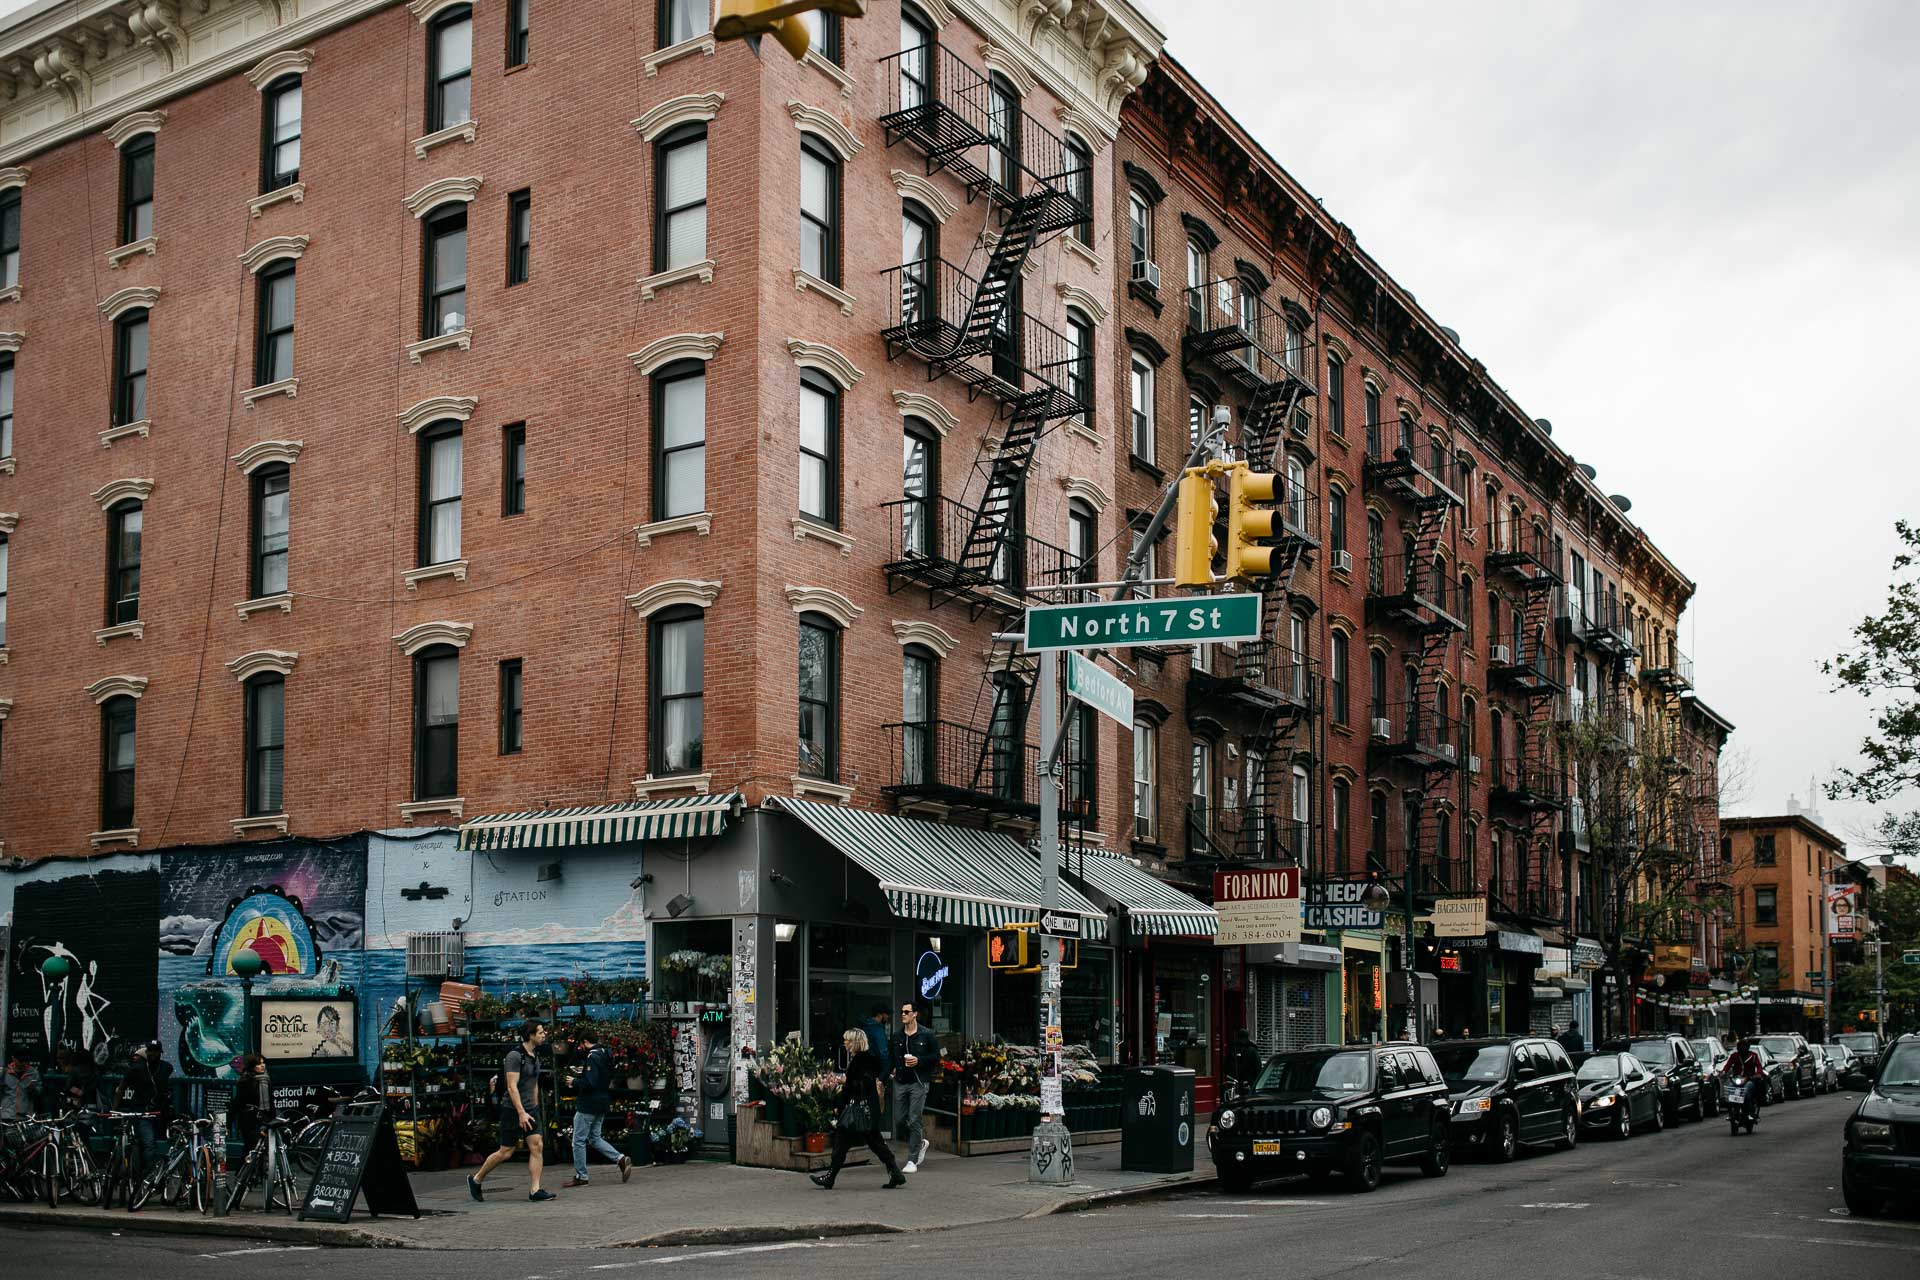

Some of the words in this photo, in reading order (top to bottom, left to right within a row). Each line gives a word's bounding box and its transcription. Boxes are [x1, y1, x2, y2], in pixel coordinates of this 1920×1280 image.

[1060, 610, 1150, 638] North
[1160, 609, 1178, 632] 7
[1187, 607, 1222, 631] St
[1077, 665, 1116, 706] Bedford
[1224, 872, 1289, 899] FORNINO
[1045, 916, 1058, 928] ONE
[1062, 918, 1076, 930] WAY
[1308, 907, 1380, 926] CASHED
[1221, 931, 1238, 940] 718
[1243, 930, 1292, 940] 384-6004
[702, 1011, 723, 1022] ATM
[273, 1087, 302, 1098] edford
[306, 1086, 316, 1096] Av
[273, 1099, 299, 1109] tation
[333, 1151, 355, 1162] BEST
[313, 1185, 352, 1199] BROOKLYN
